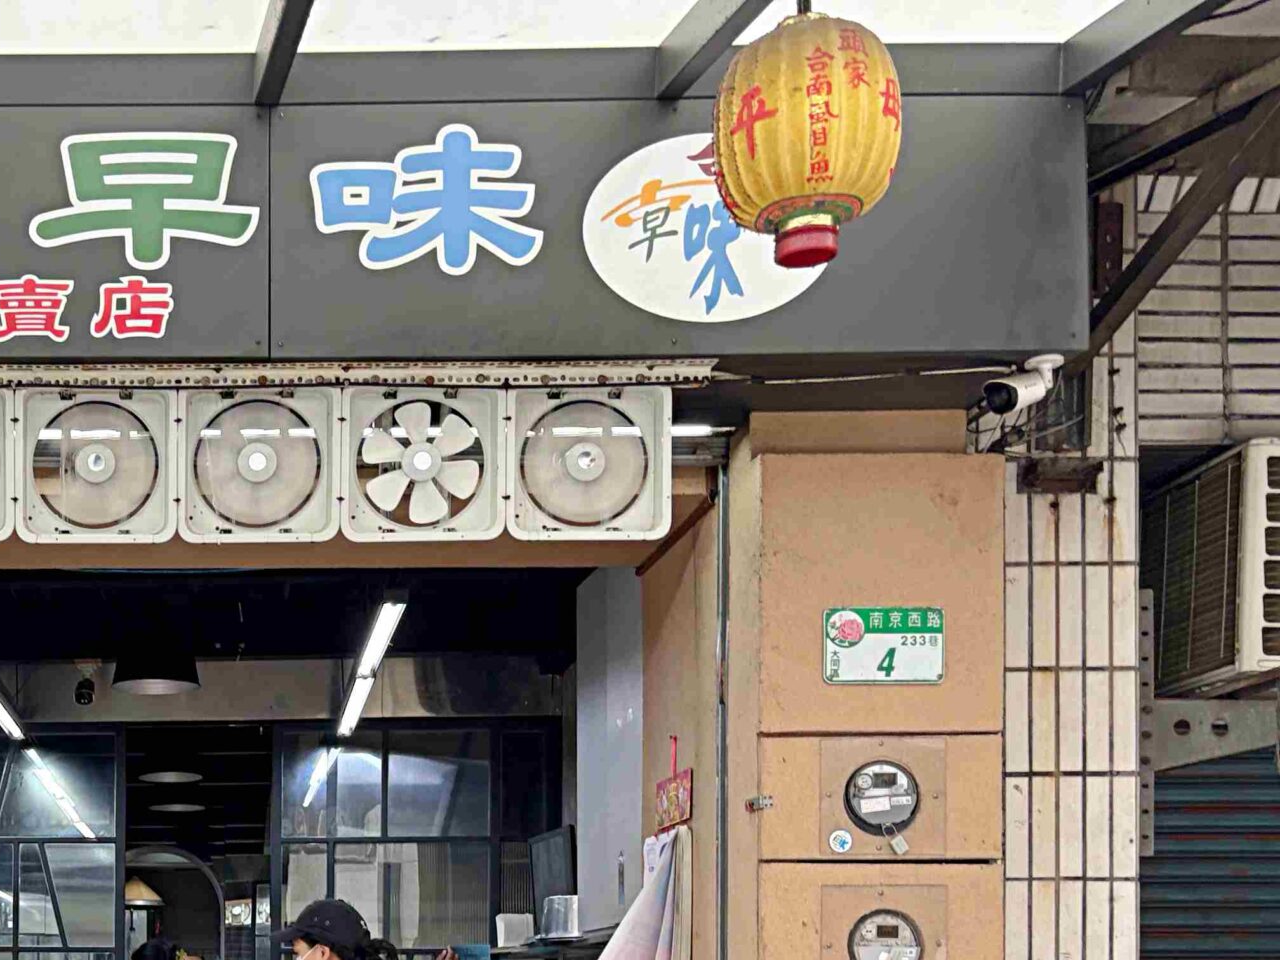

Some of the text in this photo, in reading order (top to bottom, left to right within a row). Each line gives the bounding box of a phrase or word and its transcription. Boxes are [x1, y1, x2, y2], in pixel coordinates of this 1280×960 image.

[806, 46, 839, 184] 台南虱目魚
[869, 611, 941, 629] 南京西路
[900, 635, 938, 647] 233巷
[876, 647, 897, 678] 4
